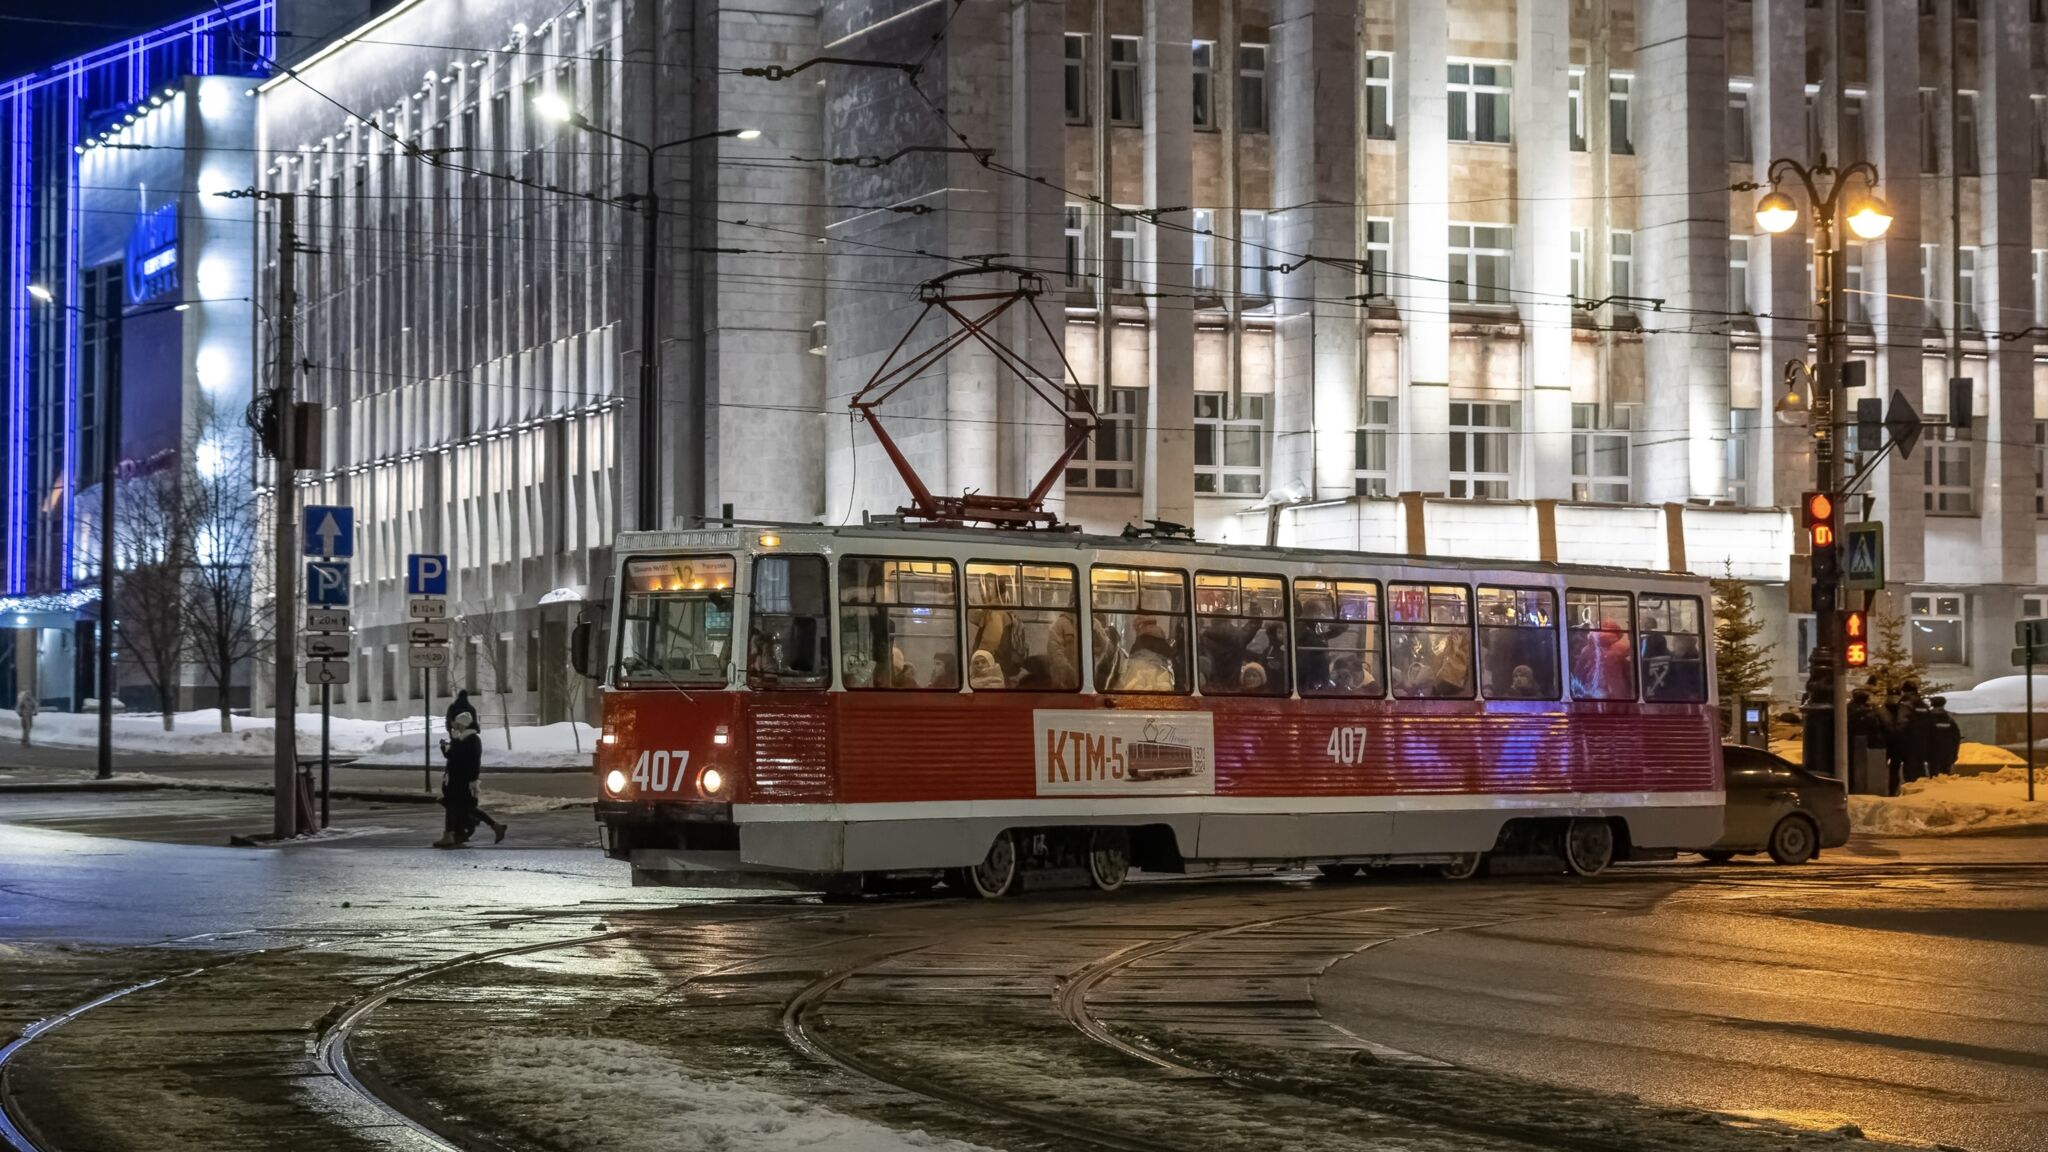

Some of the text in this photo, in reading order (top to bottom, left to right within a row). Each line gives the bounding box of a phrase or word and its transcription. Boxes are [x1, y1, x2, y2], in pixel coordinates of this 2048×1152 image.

[319, 567, 341, 601] P
[419, 557, 443, 591] P
[675, 565, 696, 583] 12
[1048, 729, 1124, 783] КТМ-5
[1327, 727, 1367, 764] 407
[631, 750, 690, 791] 407
